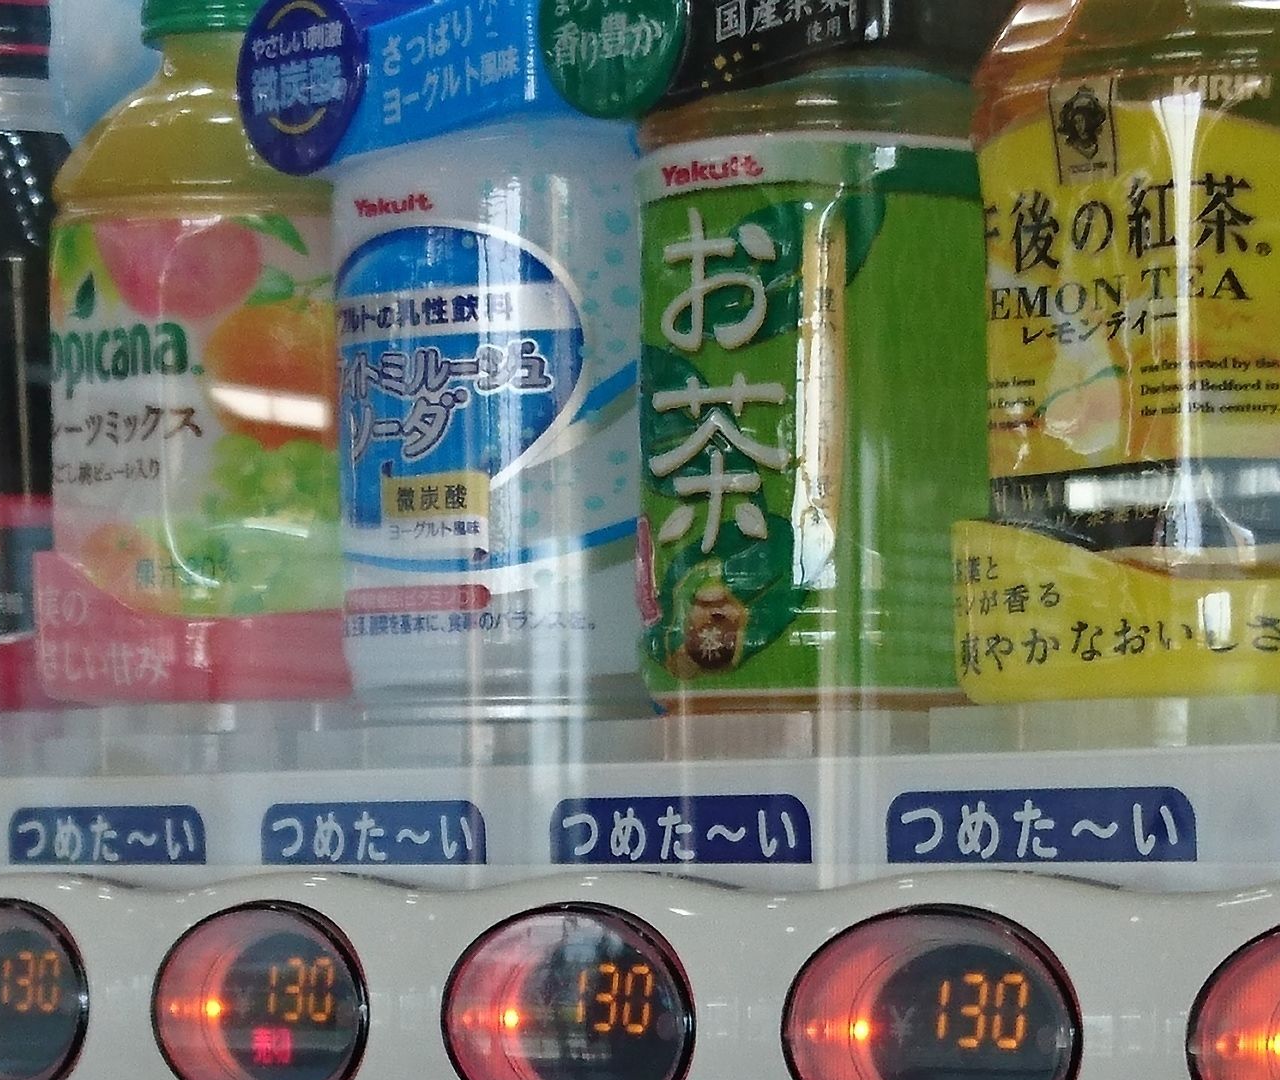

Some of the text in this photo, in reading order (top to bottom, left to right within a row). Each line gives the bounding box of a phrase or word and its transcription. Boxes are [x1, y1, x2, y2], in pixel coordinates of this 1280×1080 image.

[252, 21, 342, 60] やさしい刺激
[554, 15, 661, 70] 香り豊か
[1173, 76, 1272, 99] KIRIN
[661, 155, 764, 186] Yakult
[354, 193, 433, 216] Yakult
[1141, 267, 1251, 302] TEA
[1022, 312, 1178, 346] レモンティー
[651, 208, 789, 553] お茶
[397, 484, 467, 510] 微炭酸
[390, 521, 480, 541] ヨーグルト風味
[18, 814, 197, 862] つめた〜い
[271, 810, 473, 863] つめた〜い
[562, 807, 797, 860] つめた〜い
[901, 799, 1179, 860] つめた〜い
[267, 957, 333, 1023] 130
[574, 963, 653, 1036] 130
[934, 973, 1029, 1050] 130
